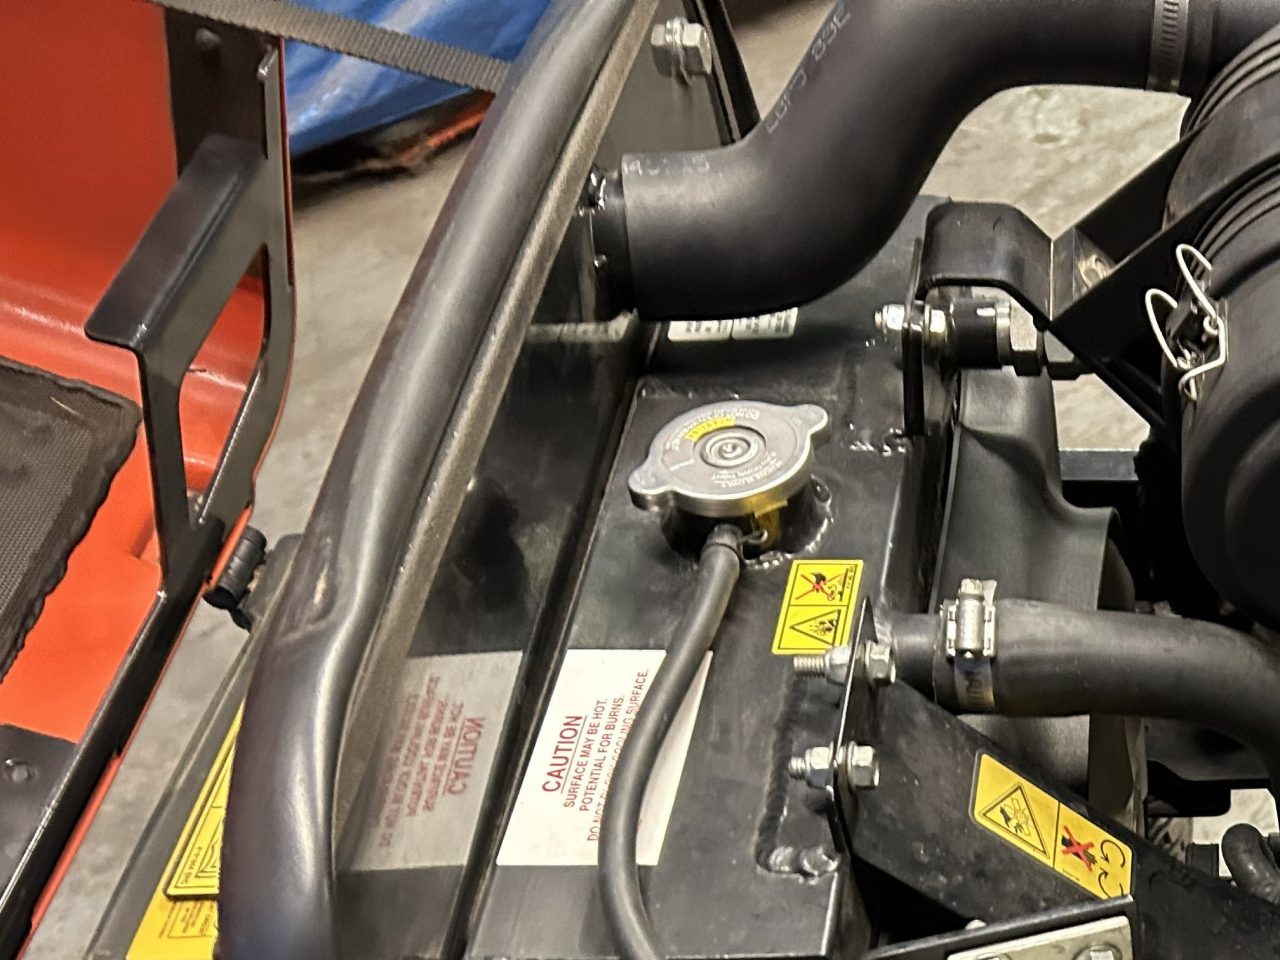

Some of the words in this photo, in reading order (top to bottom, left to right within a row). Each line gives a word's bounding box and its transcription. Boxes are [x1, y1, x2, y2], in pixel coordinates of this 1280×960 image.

[592, 697, 609, 720] HOT.
[625, 668, 649, 717] SURFACE.
[586, 722, 601, 735] BE
[604, 694, 626, 731] BURNS.
[541, 715, 584, 792] CAUTION
[579, 737, 596, 758] MAY
[597, 732, 614, 753] FOR
[563, 759, 588, 808] SURFACE
[579, 755, 607, 812] POTENTIAL
